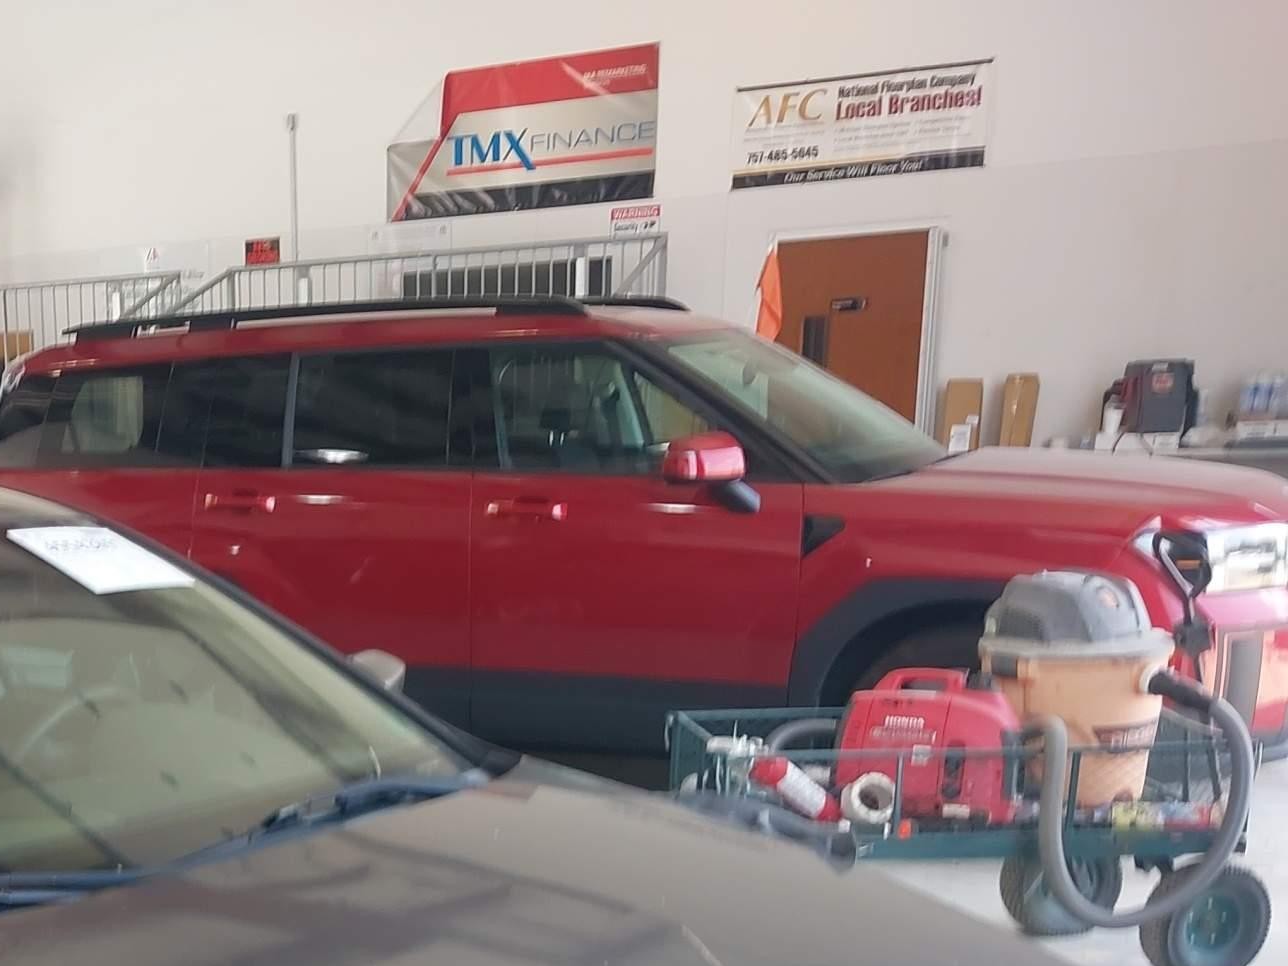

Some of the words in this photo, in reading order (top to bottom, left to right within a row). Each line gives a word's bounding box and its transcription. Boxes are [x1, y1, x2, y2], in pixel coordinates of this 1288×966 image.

[836, 96, 882, 120] Local
[888, 85, 983, 115] Branches!
[838, 81, 879, 99] National
[929, 73, 976, 88] Company
[748, 88, 828, 127] AFC
[447, 128, 536, 171] TMX
[529, 121, 656, 153] FINANCE
[884, 714, 925, 729] HONDA
